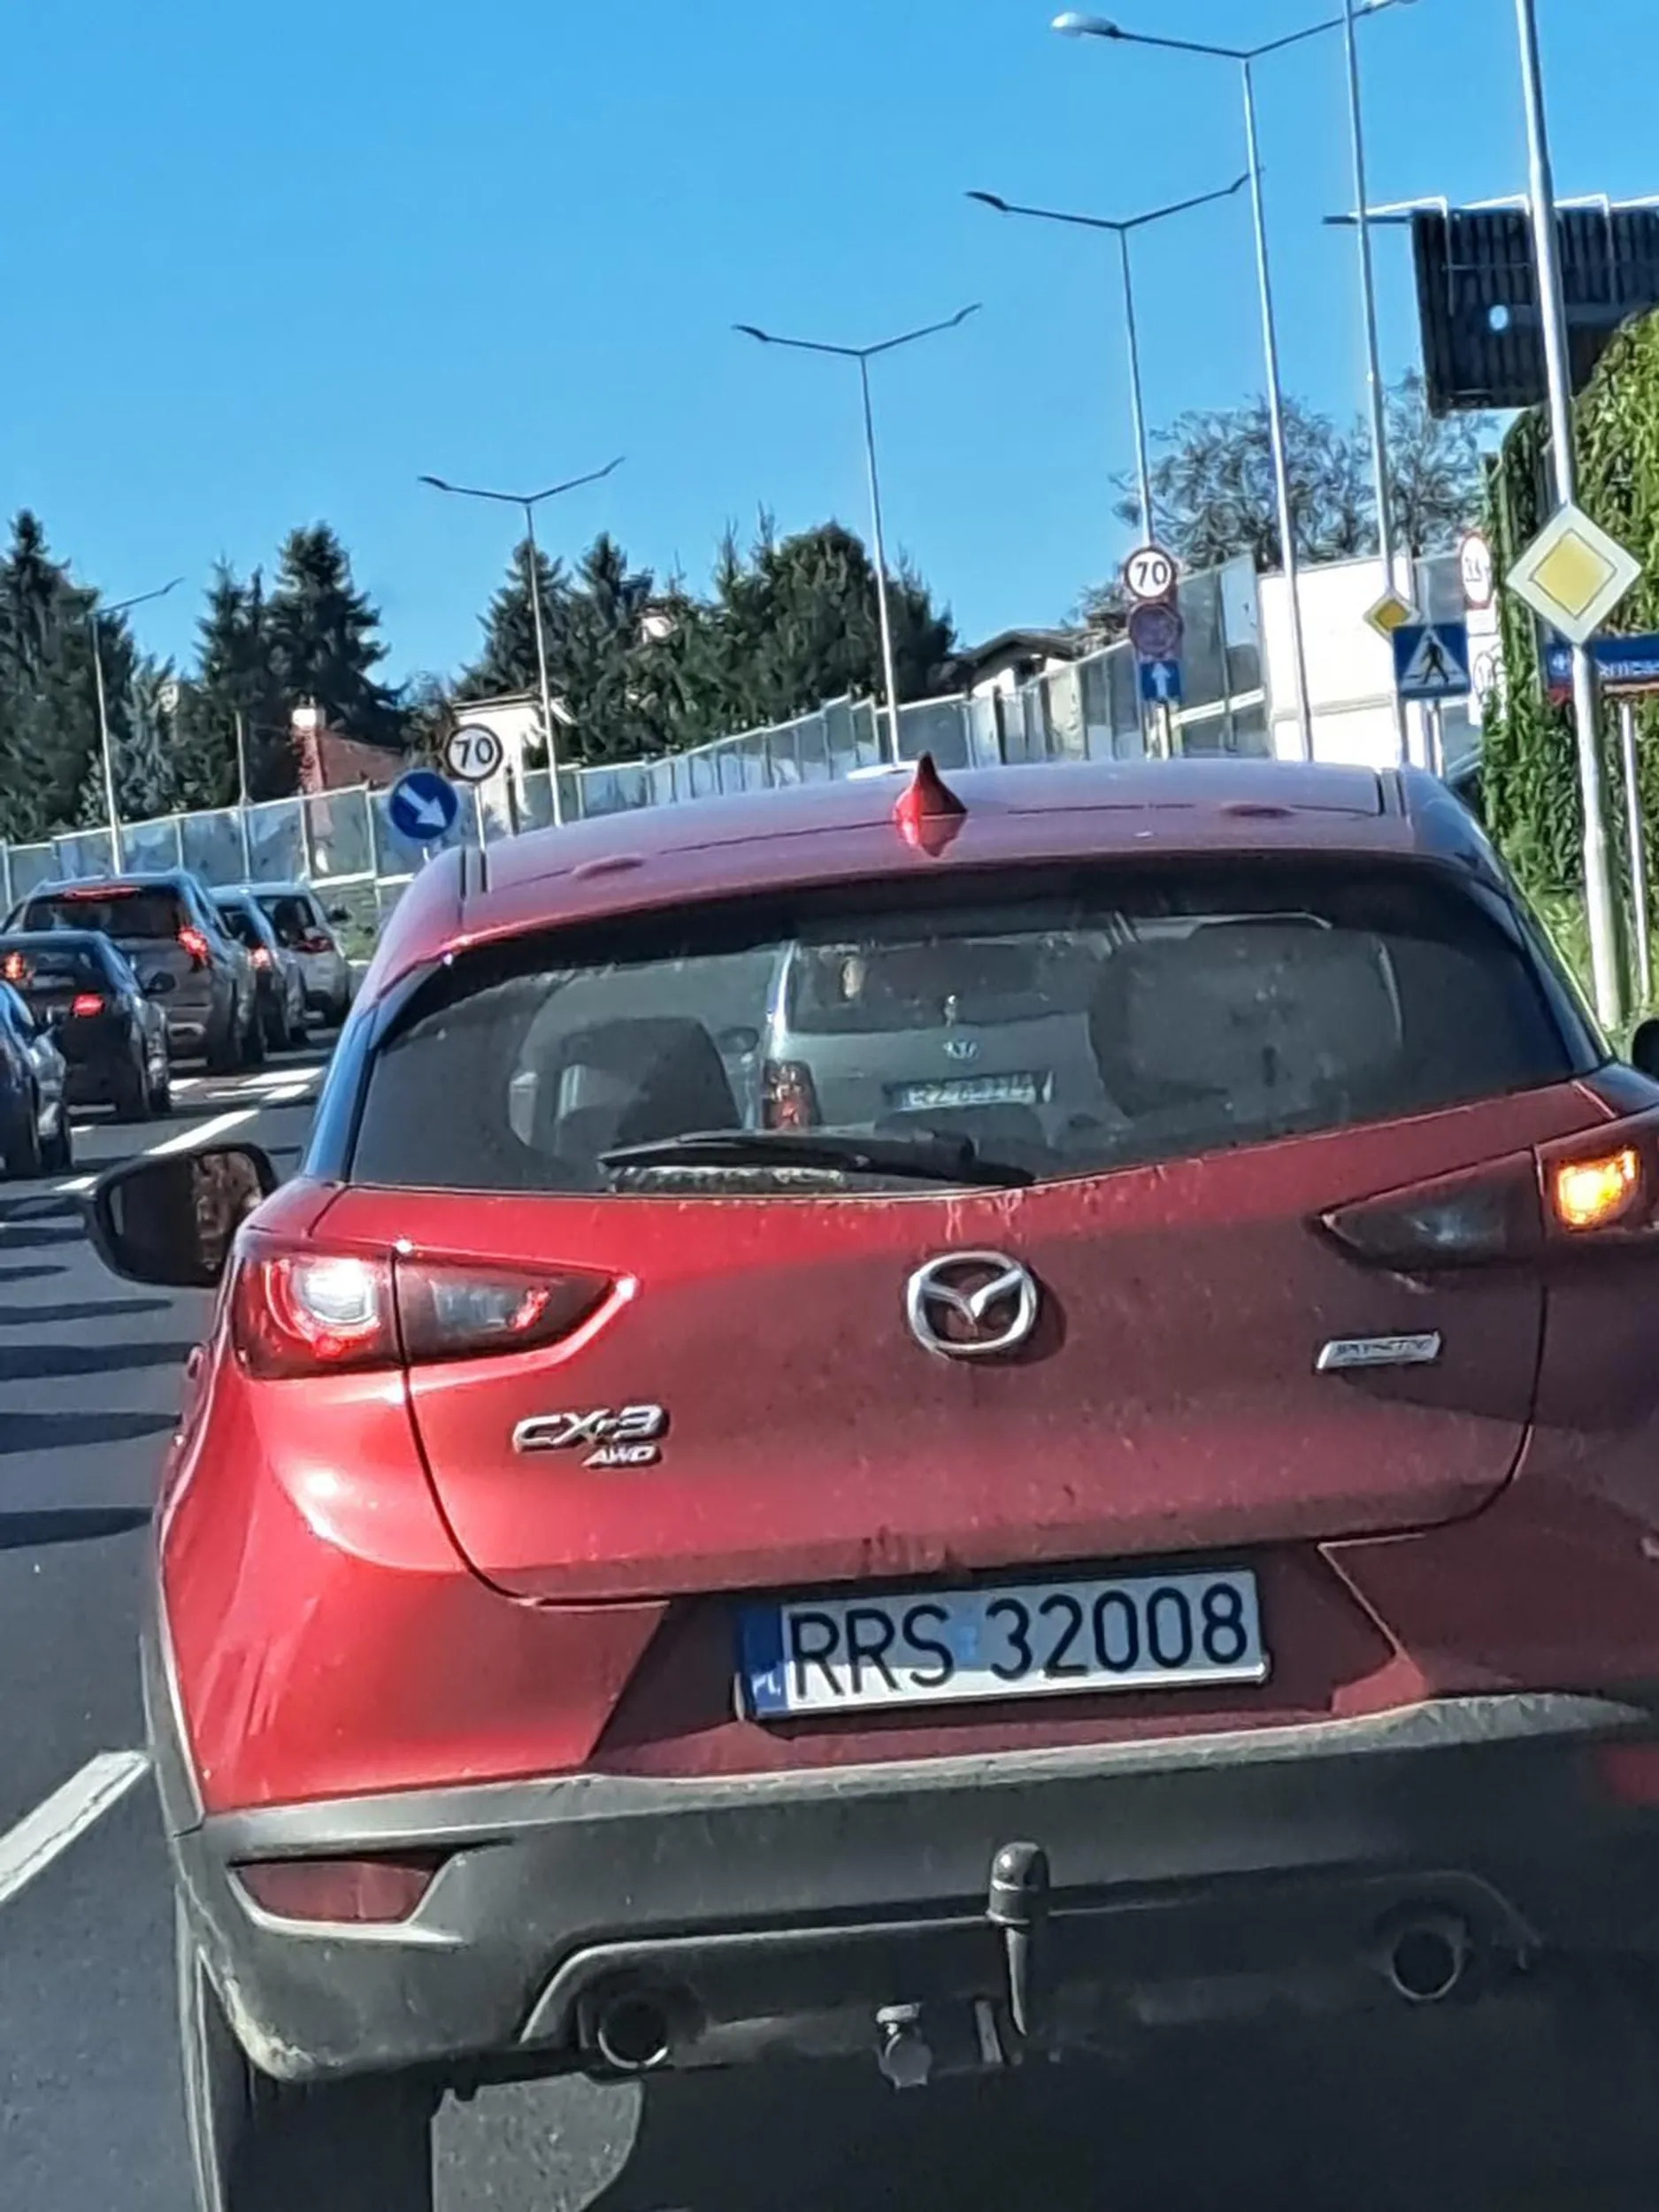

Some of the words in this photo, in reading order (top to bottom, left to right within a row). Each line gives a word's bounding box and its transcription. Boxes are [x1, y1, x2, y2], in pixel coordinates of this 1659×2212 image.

[1135, 560, 1168, 588] 70
[454, 736, 494, 770] 70
[512, 1404, 663, 1452] CX-3
[580, 1445, 657, 1467] AWD
[790, 1603, 955, 1698] RRS
[985, 1582, 1248, 1682] 32008
